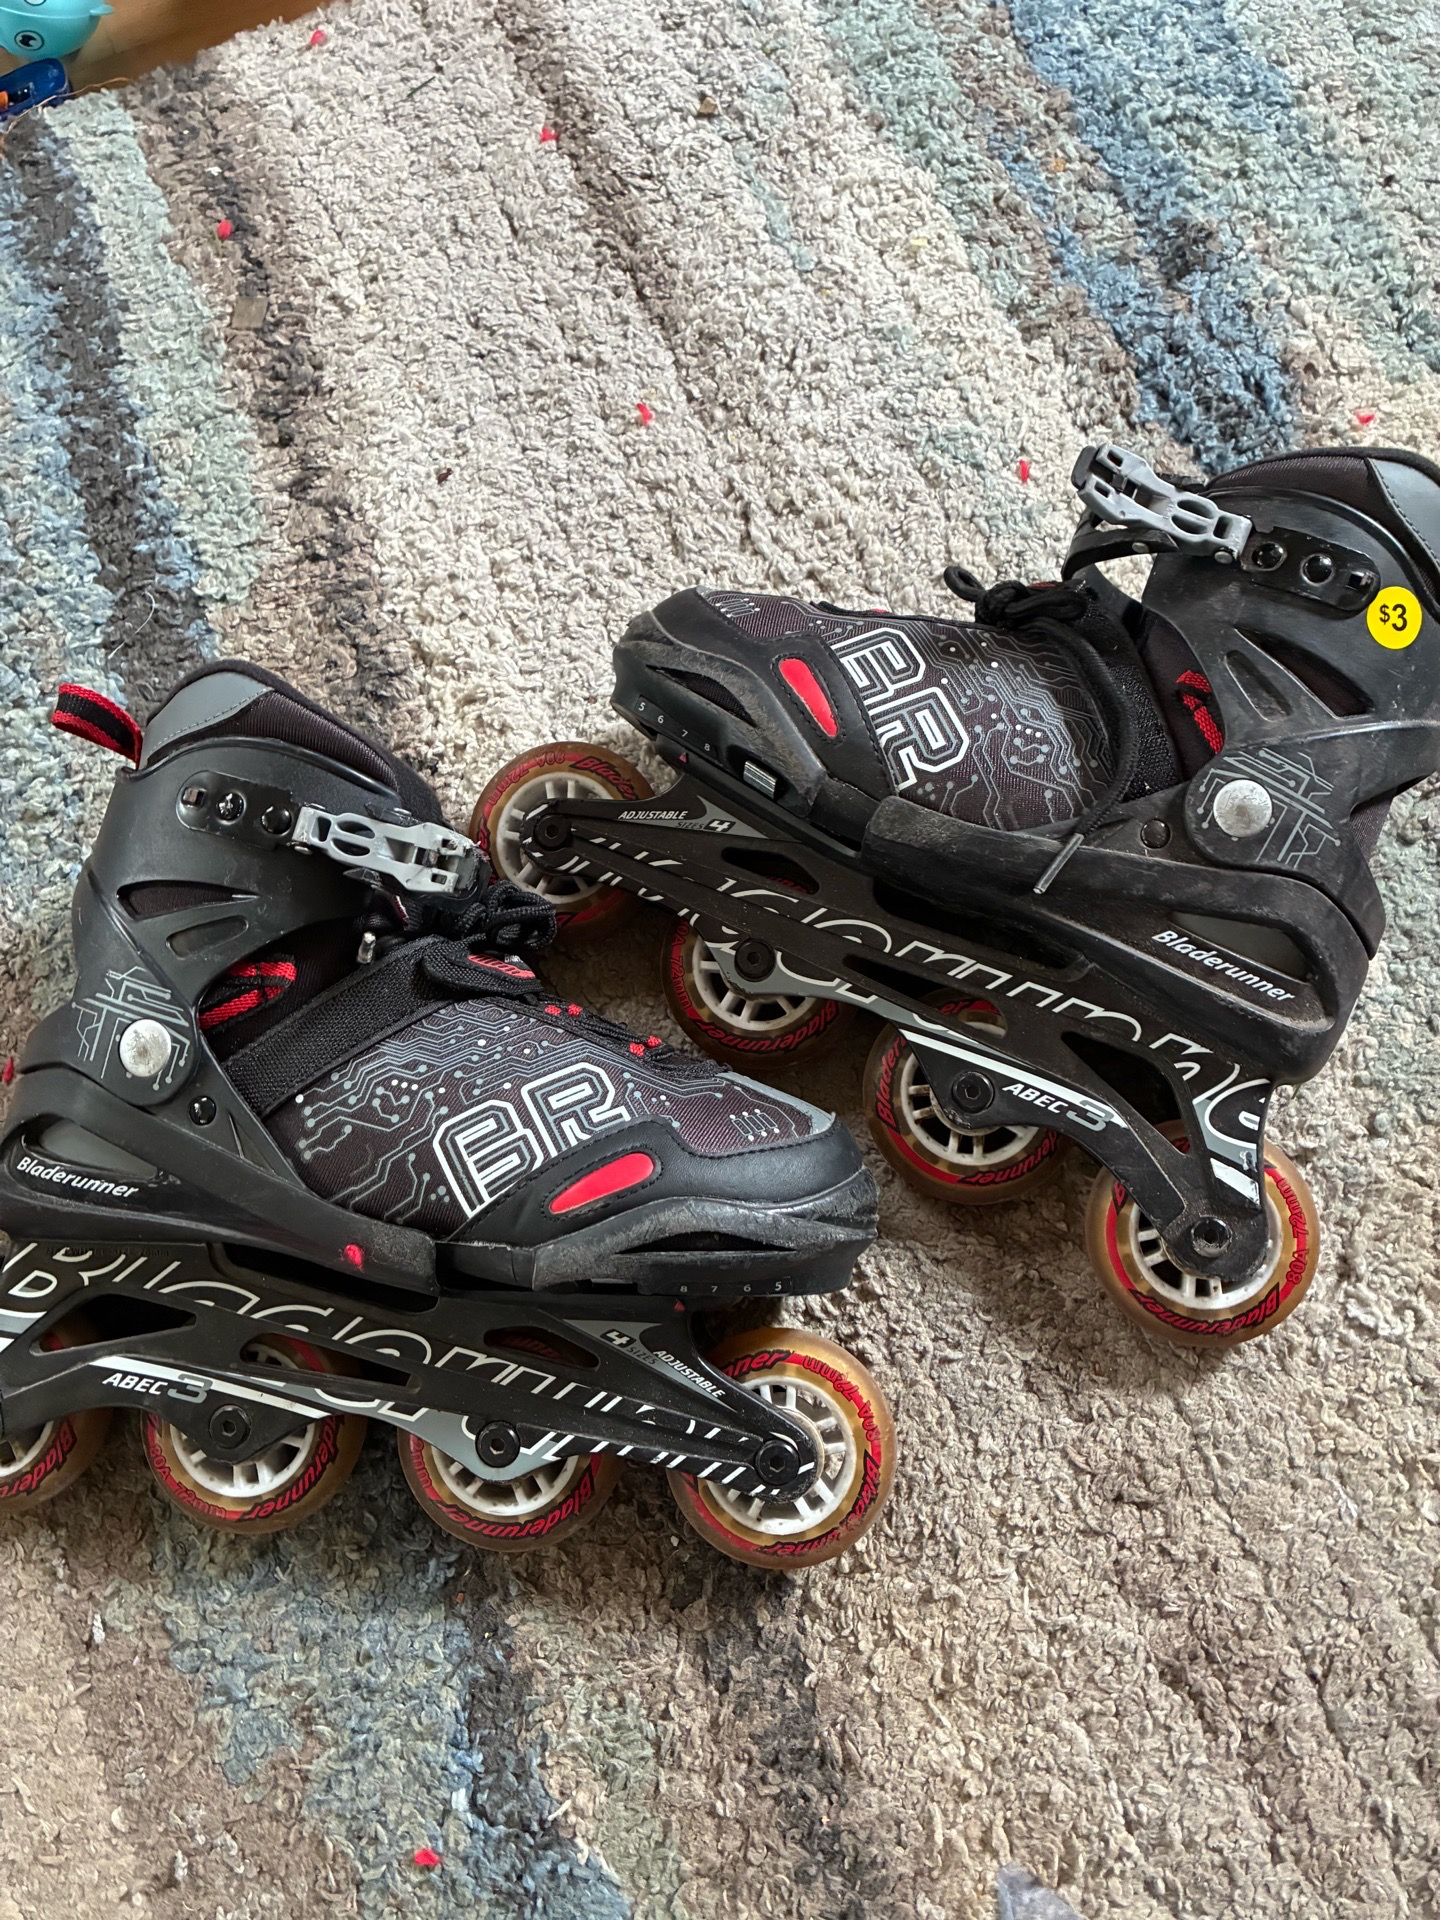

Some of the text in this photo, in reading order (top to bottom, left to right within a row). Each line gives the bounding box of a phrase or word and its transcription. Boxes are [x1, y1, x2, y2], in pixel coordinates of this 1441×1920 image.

[1379, 602, 1408, 632] $3
[638, 702, 711, 751] 5 6 7 8
[618, 810, 689, 820] ADJUSTABLE
[677, 820, 732, 832] SIZES 4
[1151, 930, 1296, 1001] Bladerunner
[694, 1000, 839, 1053] Bladerunner
[1002, 1083, 1114, 1131] ABEC 3
[432, 1062, 632, 1218] BR
[17, 1156, 138, 1199] Bladerunner
[1276, 1178, 1308, 1285] 80A 72mm
[680, 1281, 782, 1293] 8 7 6 5
[1131, 1283, 1280, 1335] Bladerunner
[605, 1330, 656, 1365] 4 SIZES
[102, 1372, 213, 1403] ABEC 3
[653, 1350, 727, 1398] ADJUSTABLE
[442, 1470, 594, 1538] Bladerunner
